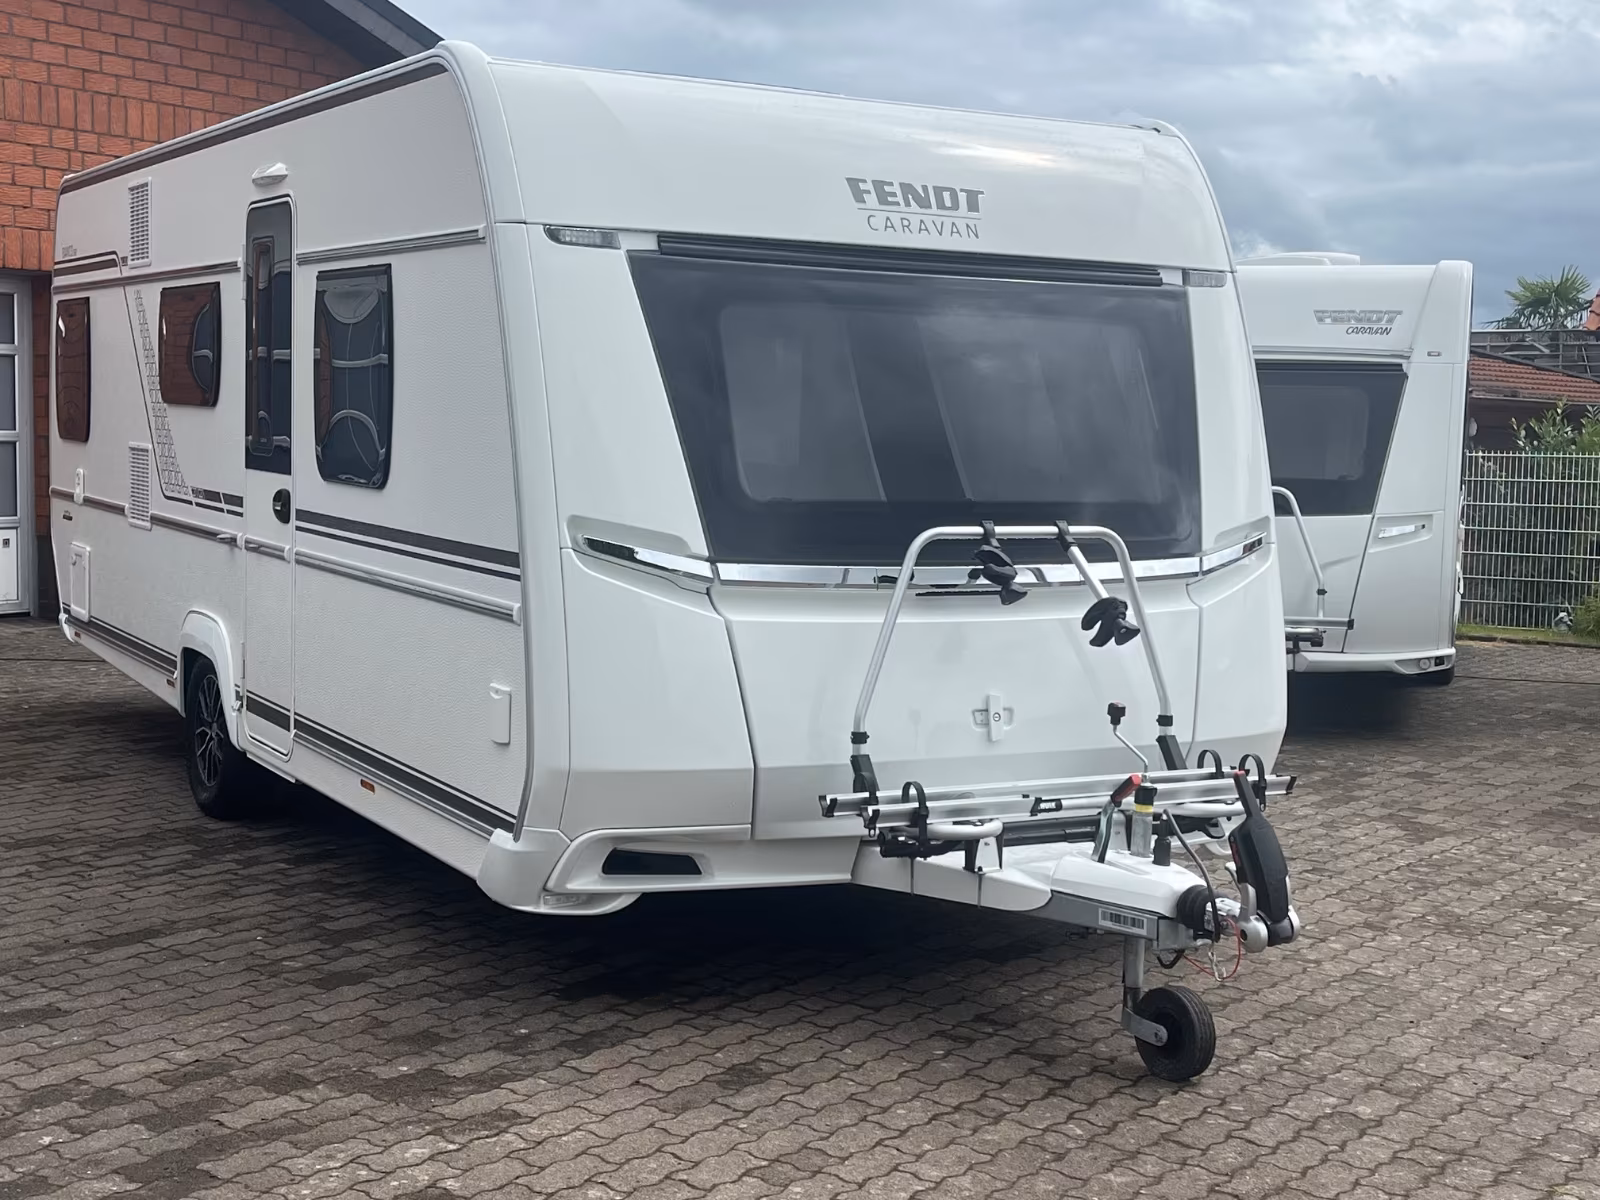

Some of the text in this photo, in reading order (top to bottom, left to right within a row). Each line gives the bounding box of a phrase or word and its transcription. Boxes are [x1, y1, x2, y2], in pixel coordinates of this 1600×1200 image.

[845, 177, 985, 214] FENDT
[867, 214, 980, 239] CARAVAN
[1313, 309, 1403, 324] FENDT
[1345, 326, 1392, 336] CARAVAN
